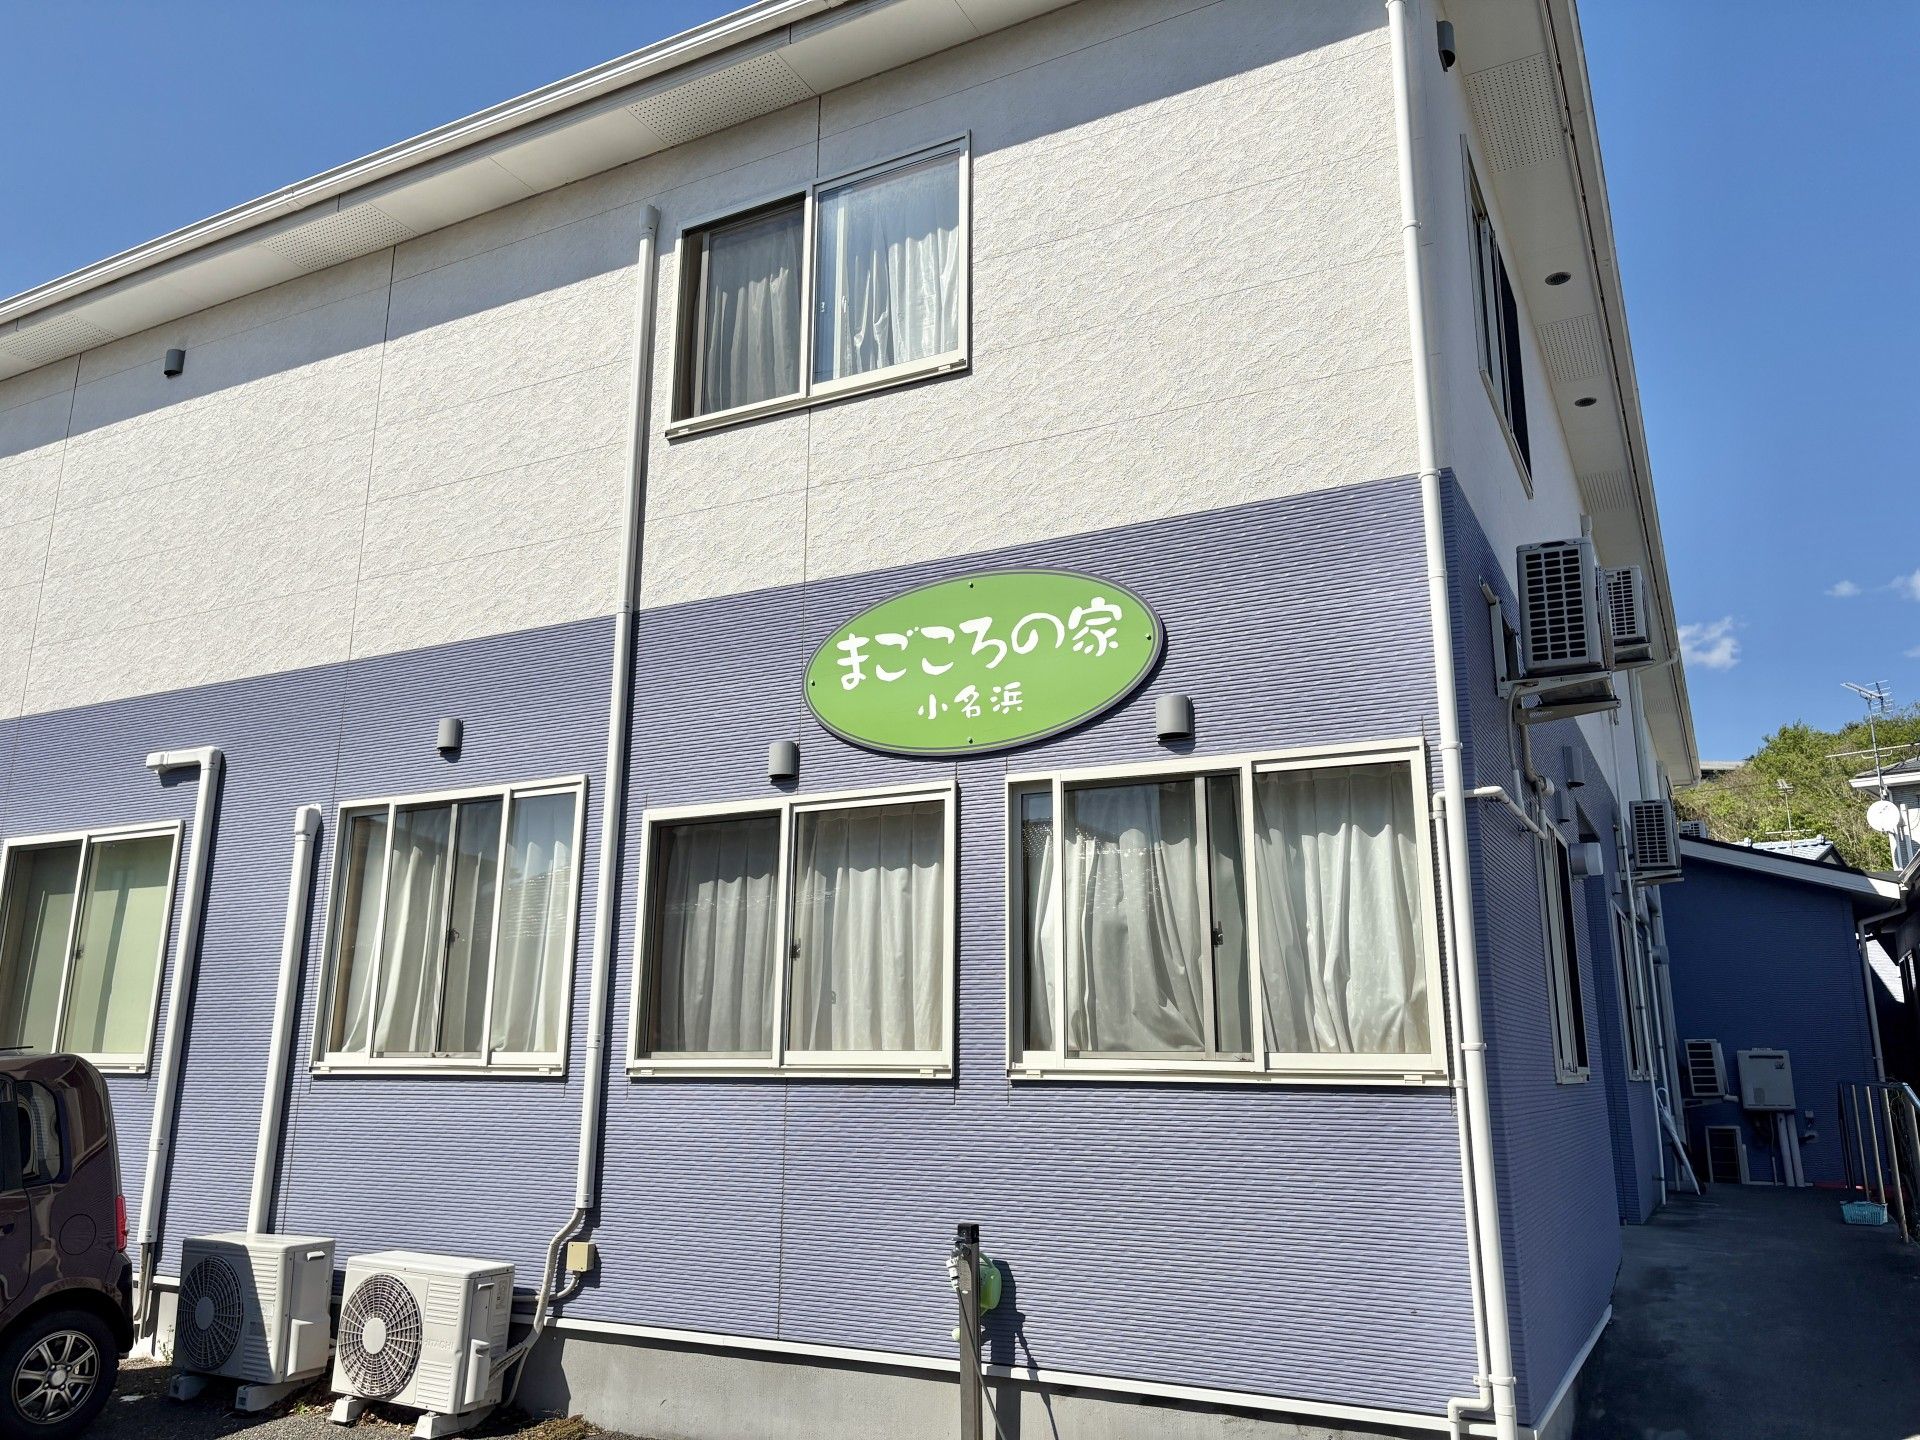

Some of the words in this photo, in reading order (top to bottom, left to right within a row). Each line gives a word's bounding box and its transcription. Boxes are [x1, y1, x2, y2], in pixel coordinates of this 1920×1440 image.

[837, 596, 1122, 691] まごころの家
[917, 681, 1024, 720] 小名浜
